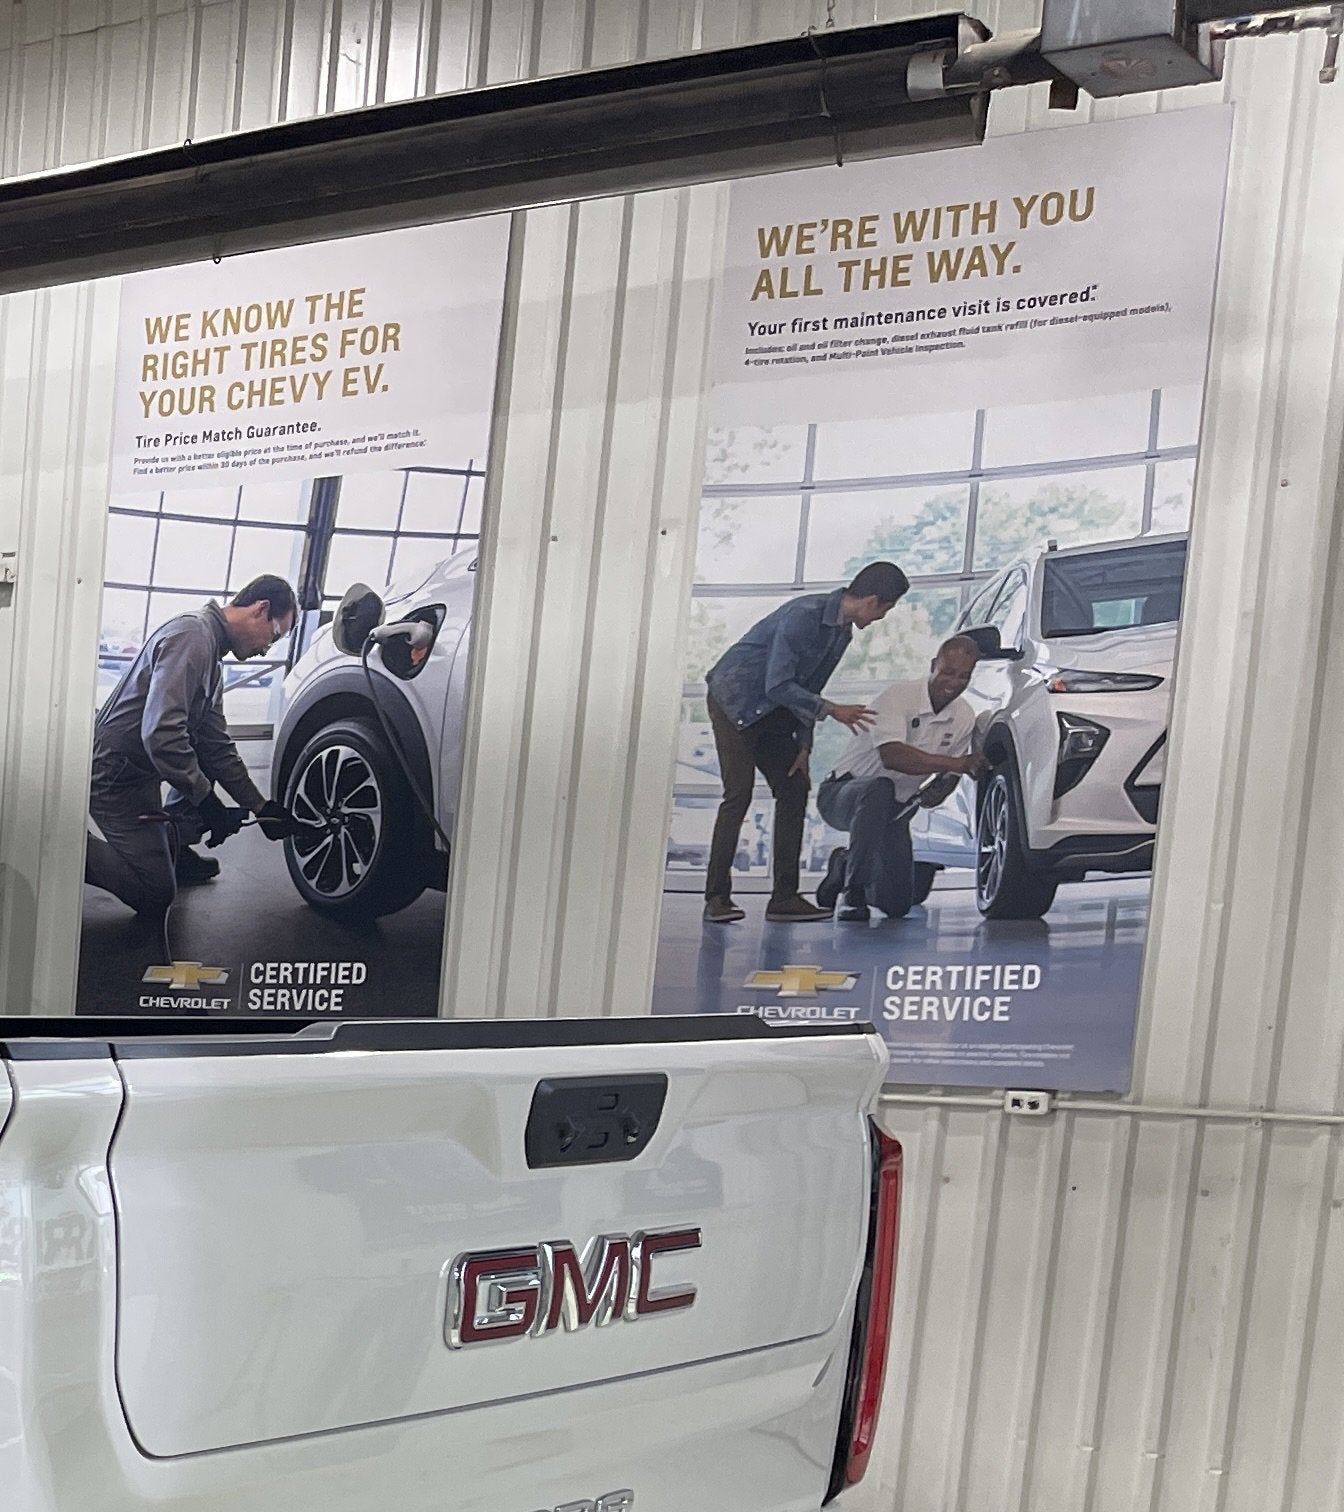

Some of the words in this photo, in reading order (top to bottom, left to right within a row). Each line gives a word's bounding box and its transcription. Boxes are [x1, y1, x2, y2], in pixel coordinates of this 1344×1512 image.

[758, 215, 880, 259] WE'RE
[893, 200, 998, 244] WITH
[1011, 187, 1096, 229] YOU
[751, 263, 823, 301] ALL
[837, 254, 913, 293] THE
[927, 241, 1022, 284] WAY.
[145, 313, 190, 345] WE
[201, 299, 295, 339] KNOW
[305, 288, 365, 325] THE
[748, 321, 786, 336] Your
[791, 317, 828, 333] first
[833, 307, 947, 330] maintenance
[952, 299, 990, 317] visit
[996, 297, 1010, 312] is
[141, 344, 231, 382] RIGHT
[240, 332, 328, 372] TIRES
[340, 322, 401, 358] FOR
[139, 385, 215, 419] YOUR
[228, 371, 333, 408] CHEVY
[342, 363, 389, 397] EV.
[136, 435, 160, 448] Tire
[165, 432, 198, 446] Price
[202, 427, 242, 443] Match
[246, 421, 321, 439] Guarantee.
[250, 962, 367, 985] CERTIFIED
[886, 964, 1041, 991] CERTIFIED
[139, 995, 231, 1009] CHEVROLET
[247, 989, 343, 1011] SERVICE
[737, 1005, 860, 1019] CHEVROLET
[882, 996, 1011, 1022] SERVICE
[442, 1224, 703, 1351] GMC
